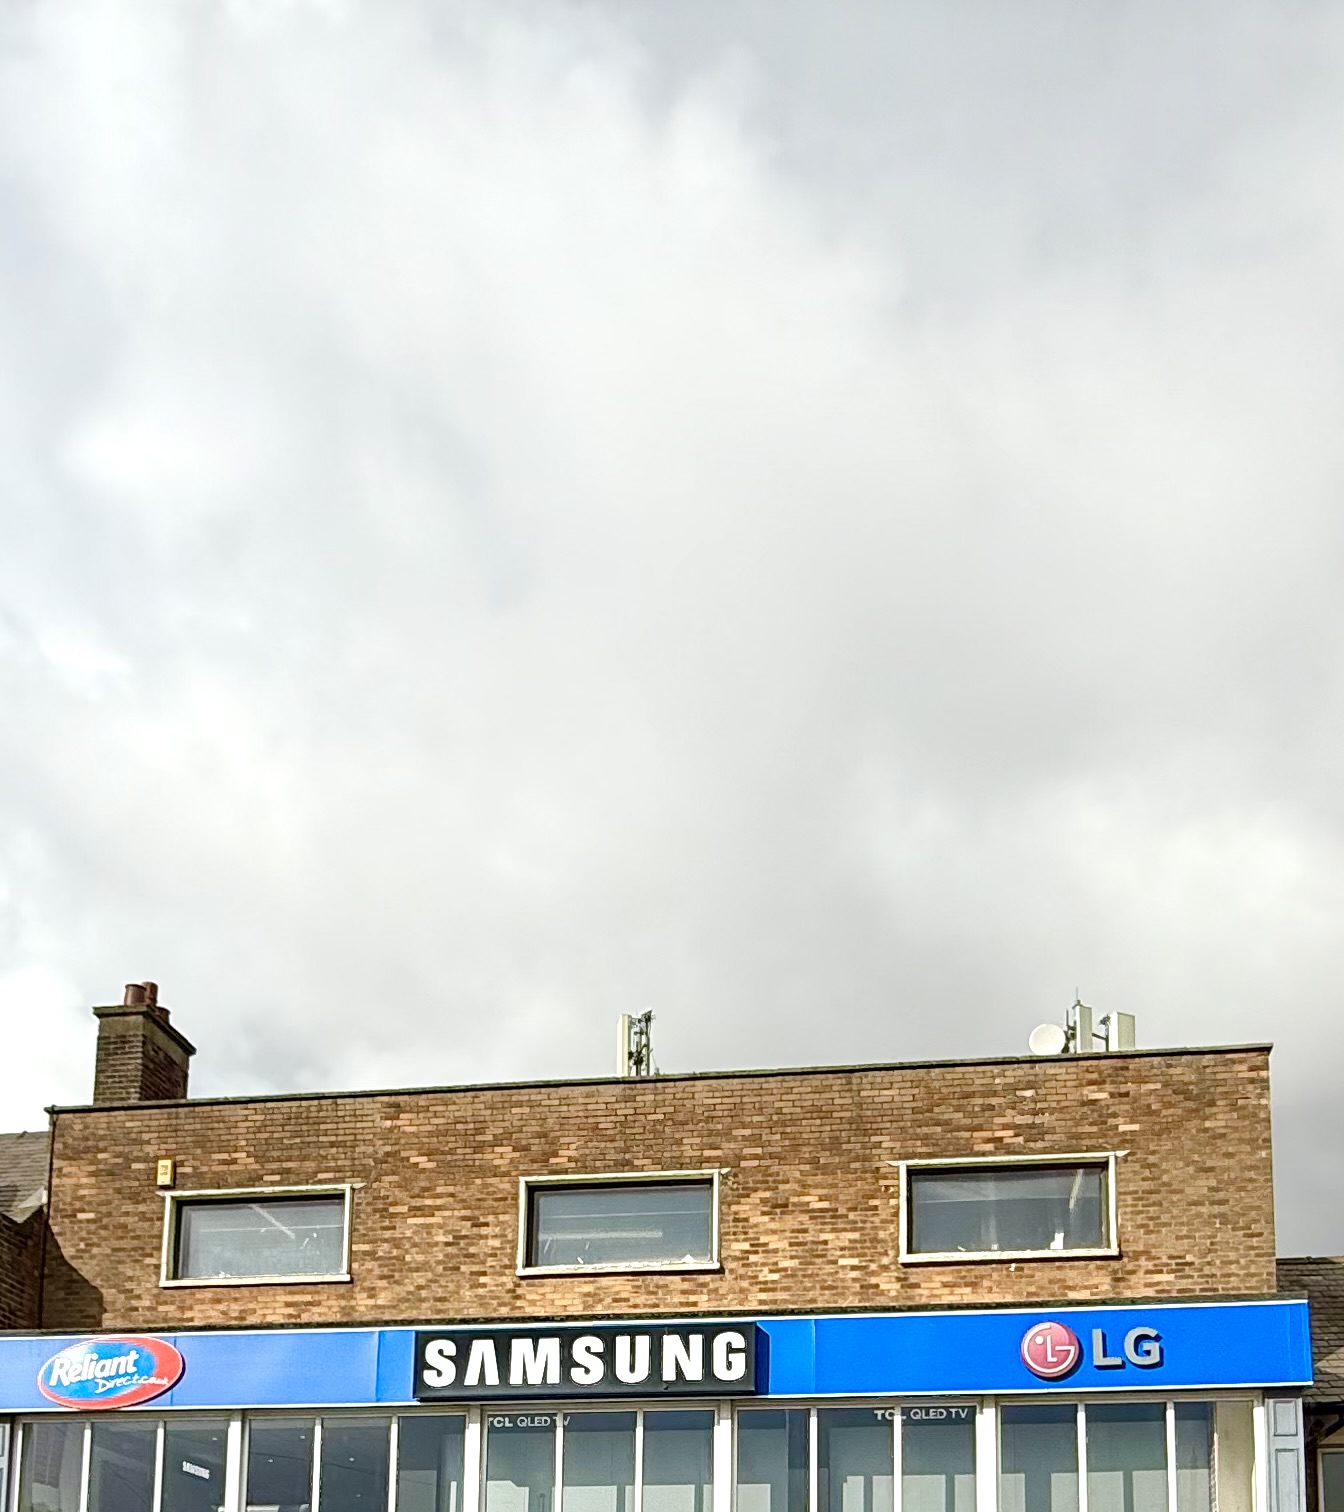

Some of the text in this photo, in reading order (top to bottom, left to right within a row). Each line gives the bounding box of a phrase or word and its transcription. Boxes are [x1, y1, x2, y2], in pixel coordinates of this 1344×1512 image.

[422, 1330, 748, 1388] SAMSUNG
[1092, 1326, 1160, 1366] LG
[49, 1350, 139, 1387] Reliant
[517, 1416, 550, 1427] QLED
[873, 1408, 968, 1420] TC QLED TV
